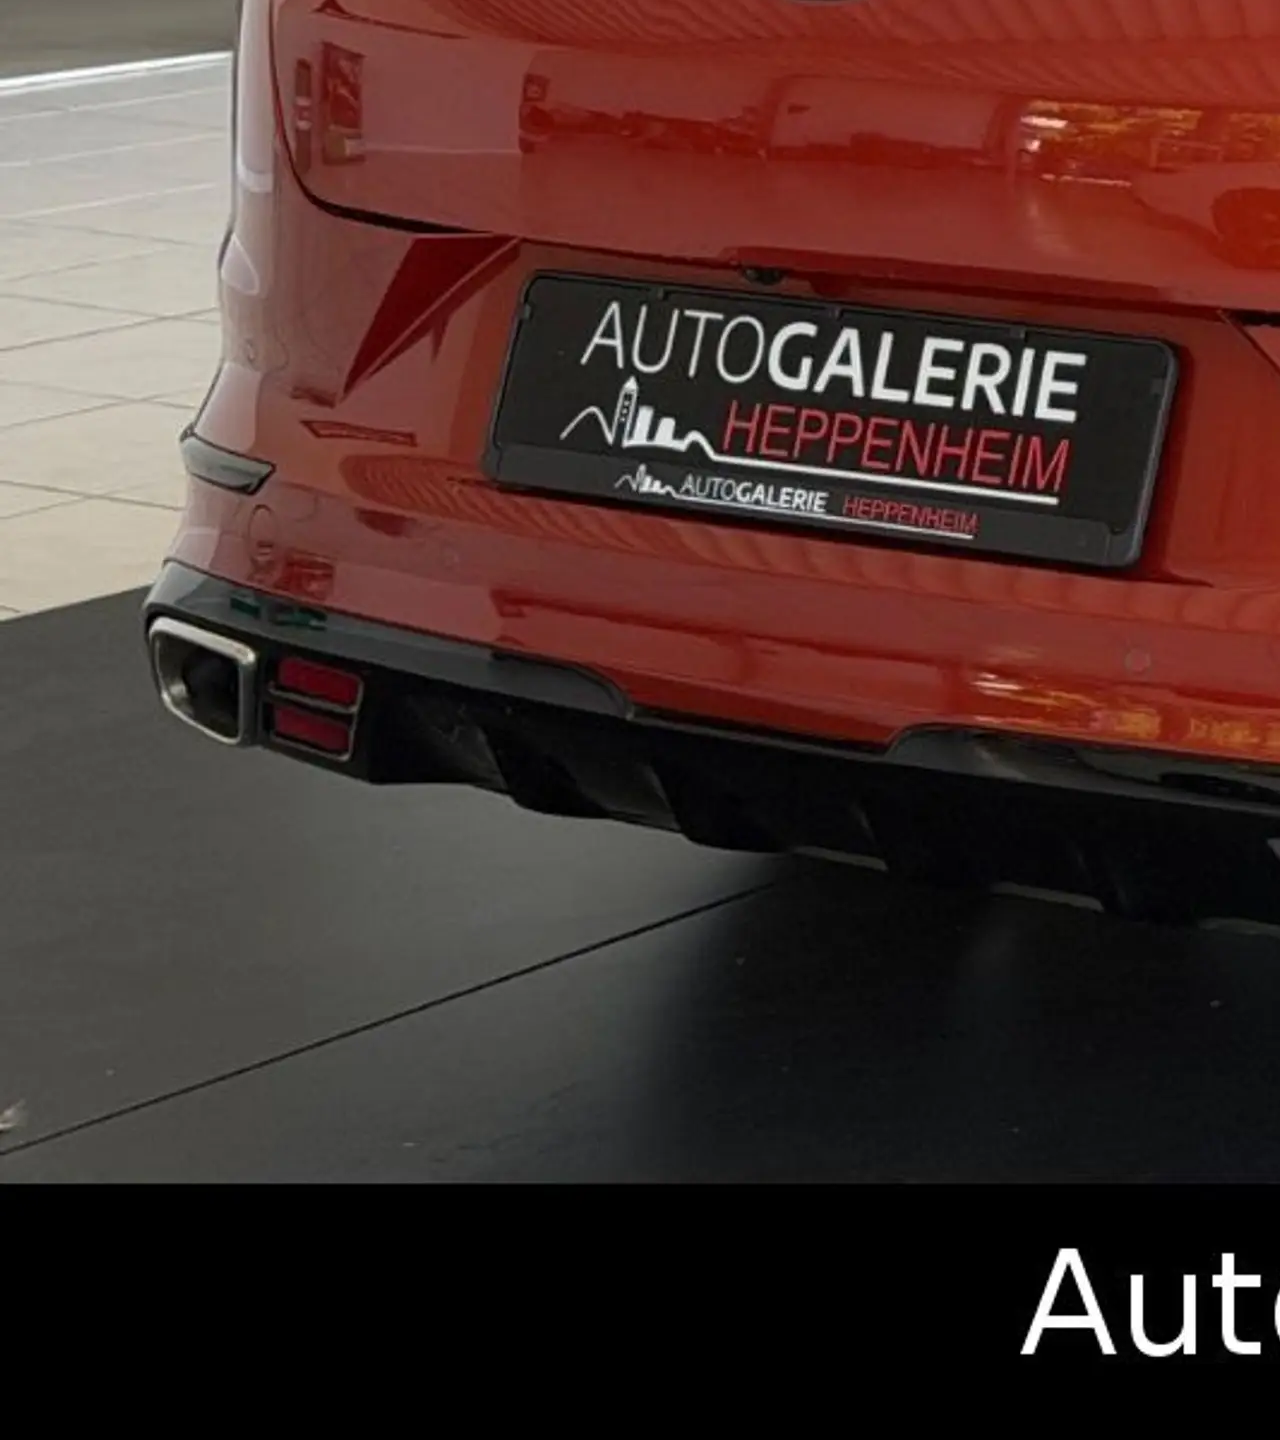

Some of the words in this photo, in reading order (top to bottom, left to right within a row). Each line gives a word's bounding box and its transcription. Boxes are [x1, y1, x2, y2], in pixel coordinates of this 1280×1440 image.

[580, 301, 1086, 423] AUTOGALERIE
[721, 399, 1071, 493] HEPPENHEIM
[680, 473, 829, 513] AUTOGALERIE
[841, 496, 978, 535] HEPPENHEIM
